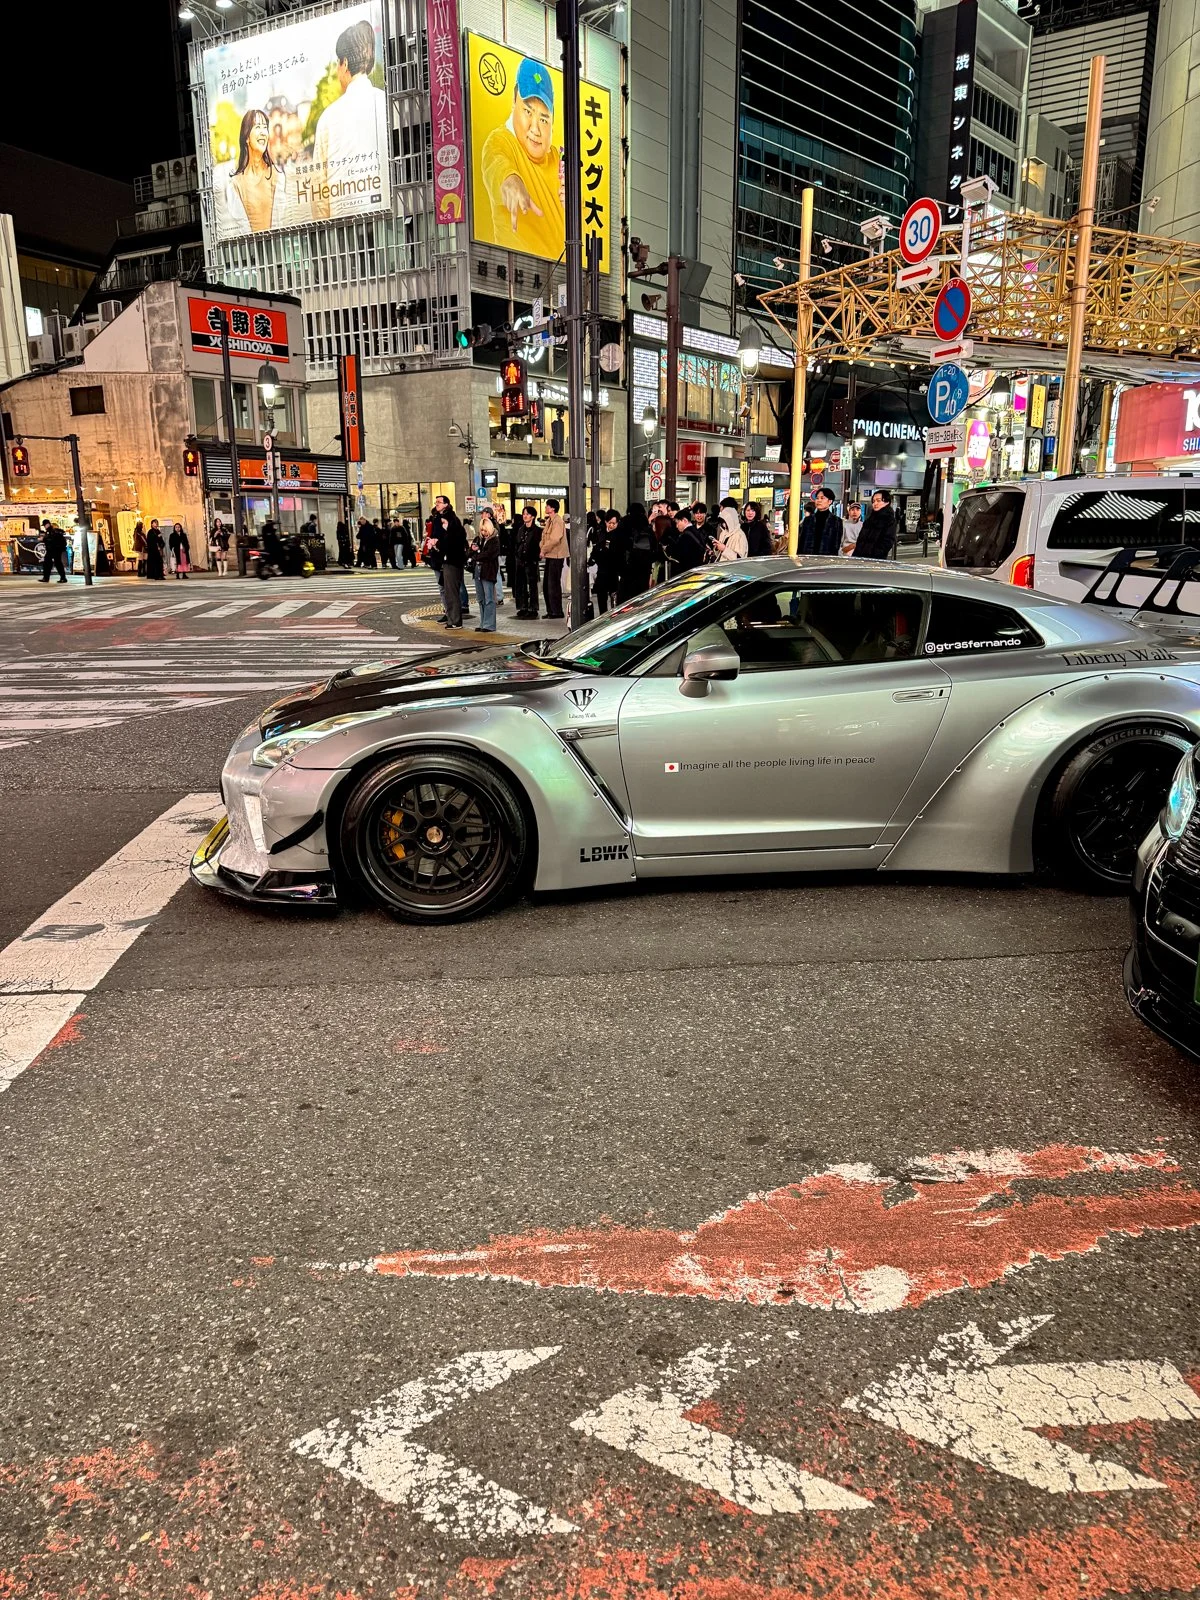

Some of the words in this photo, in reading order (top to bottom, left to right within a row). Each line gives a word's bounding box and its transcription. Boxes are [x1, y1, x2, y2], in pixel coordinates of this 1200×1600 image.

[221, 56, 260, 80] ちょっとだけ
[311, 174, 381, 202] Healmate
[908, 215, 932, 247] 30
[207, 305, 273, 339] 吉野家
[935, 380, 951, 418] P
[853, 419, 880, 437] TOHO
[882, 422, 929, 441] CINEMAS
[265, 436, 271, 449] 3
[992, 439, 998, 449] 4
[1061, 653, 1127, 667] Liberty
[1125, 648, 1180, 662] Walk
[1105, 728, 1163, 746] MICHELIN
[680, 761, 720, 772] Imagine
[721, 760, 734, 769] all
[735, 760, 752, 769] the
[753, 759, 787, 770] people
[789, 758, 815, 768] living
[817, 756, 832, 766] life
[834, 757, 843, 765] in
[845, 757, 876, 767] peace
[580, 845, 629, 863] LBWK
